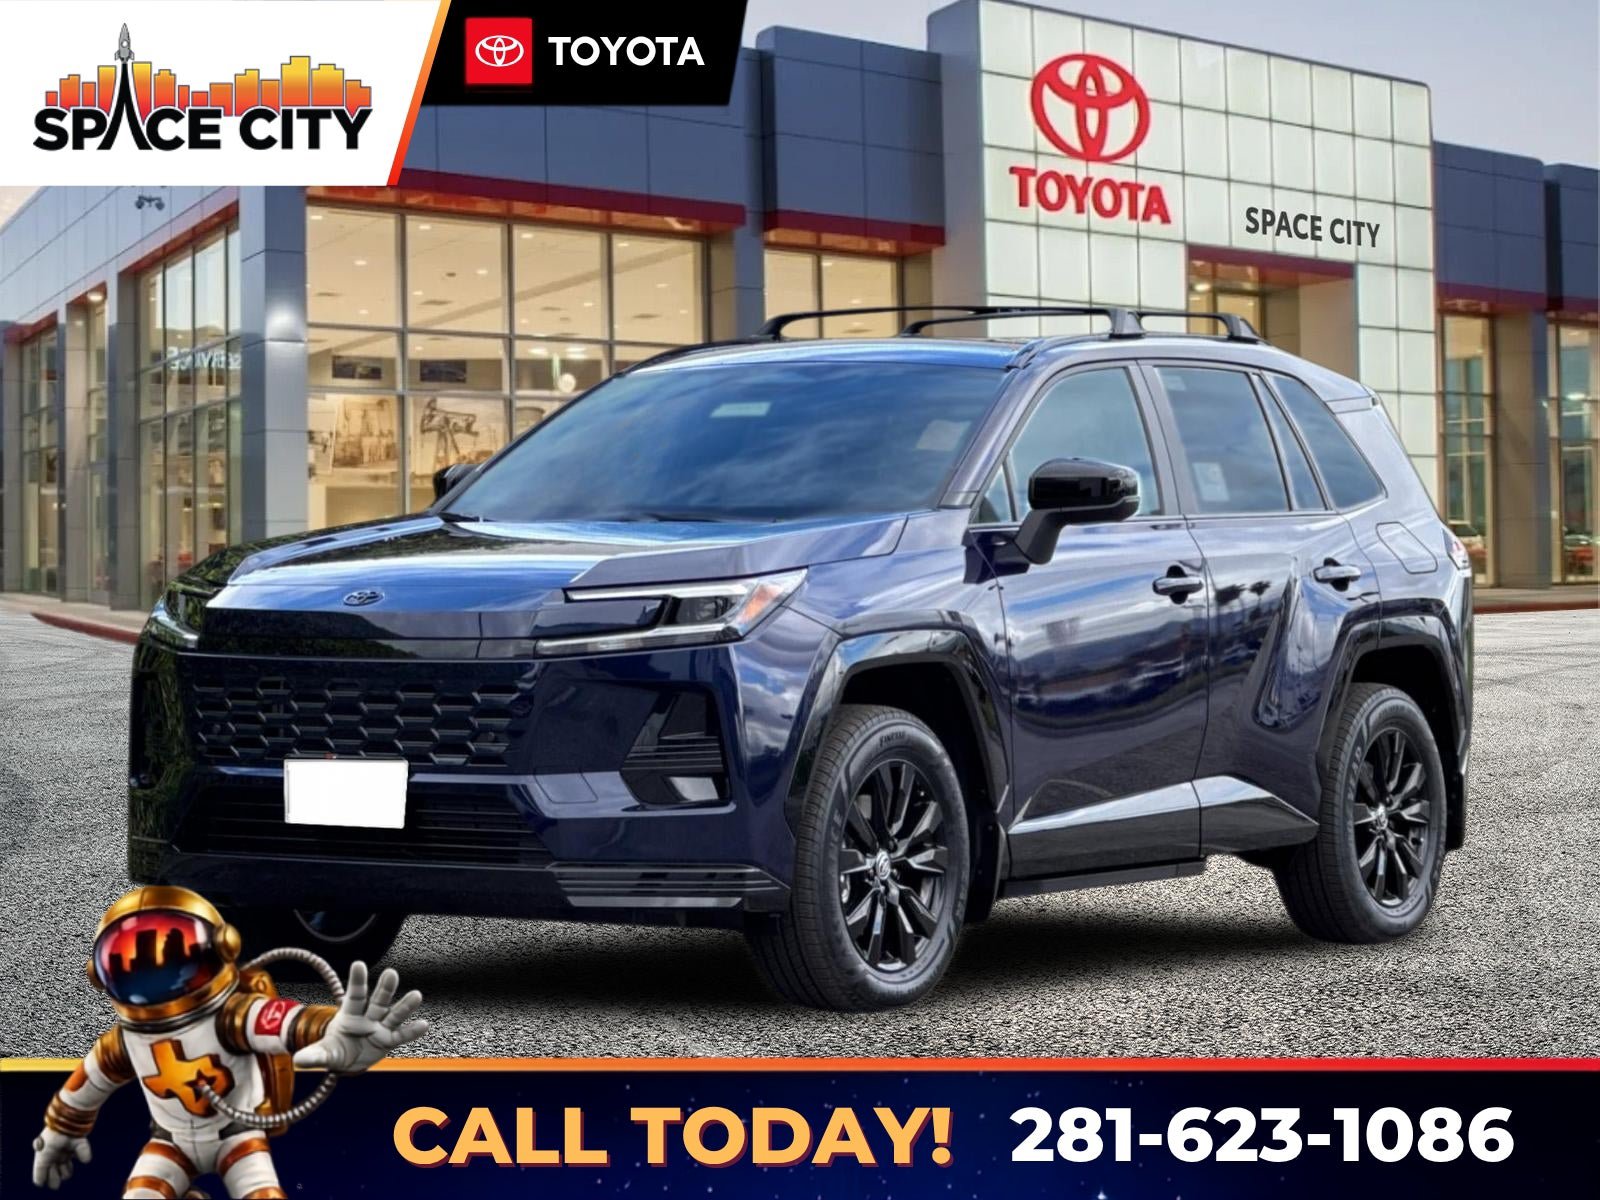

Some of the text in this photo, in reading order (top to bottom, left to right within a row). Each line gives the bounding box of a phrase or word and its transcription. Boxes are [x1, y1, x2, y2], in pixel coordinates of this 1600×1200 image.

[1009, 166, 1172, 226] TOYOTA
[1245, 206, 1381, 248] SPACE CITY
